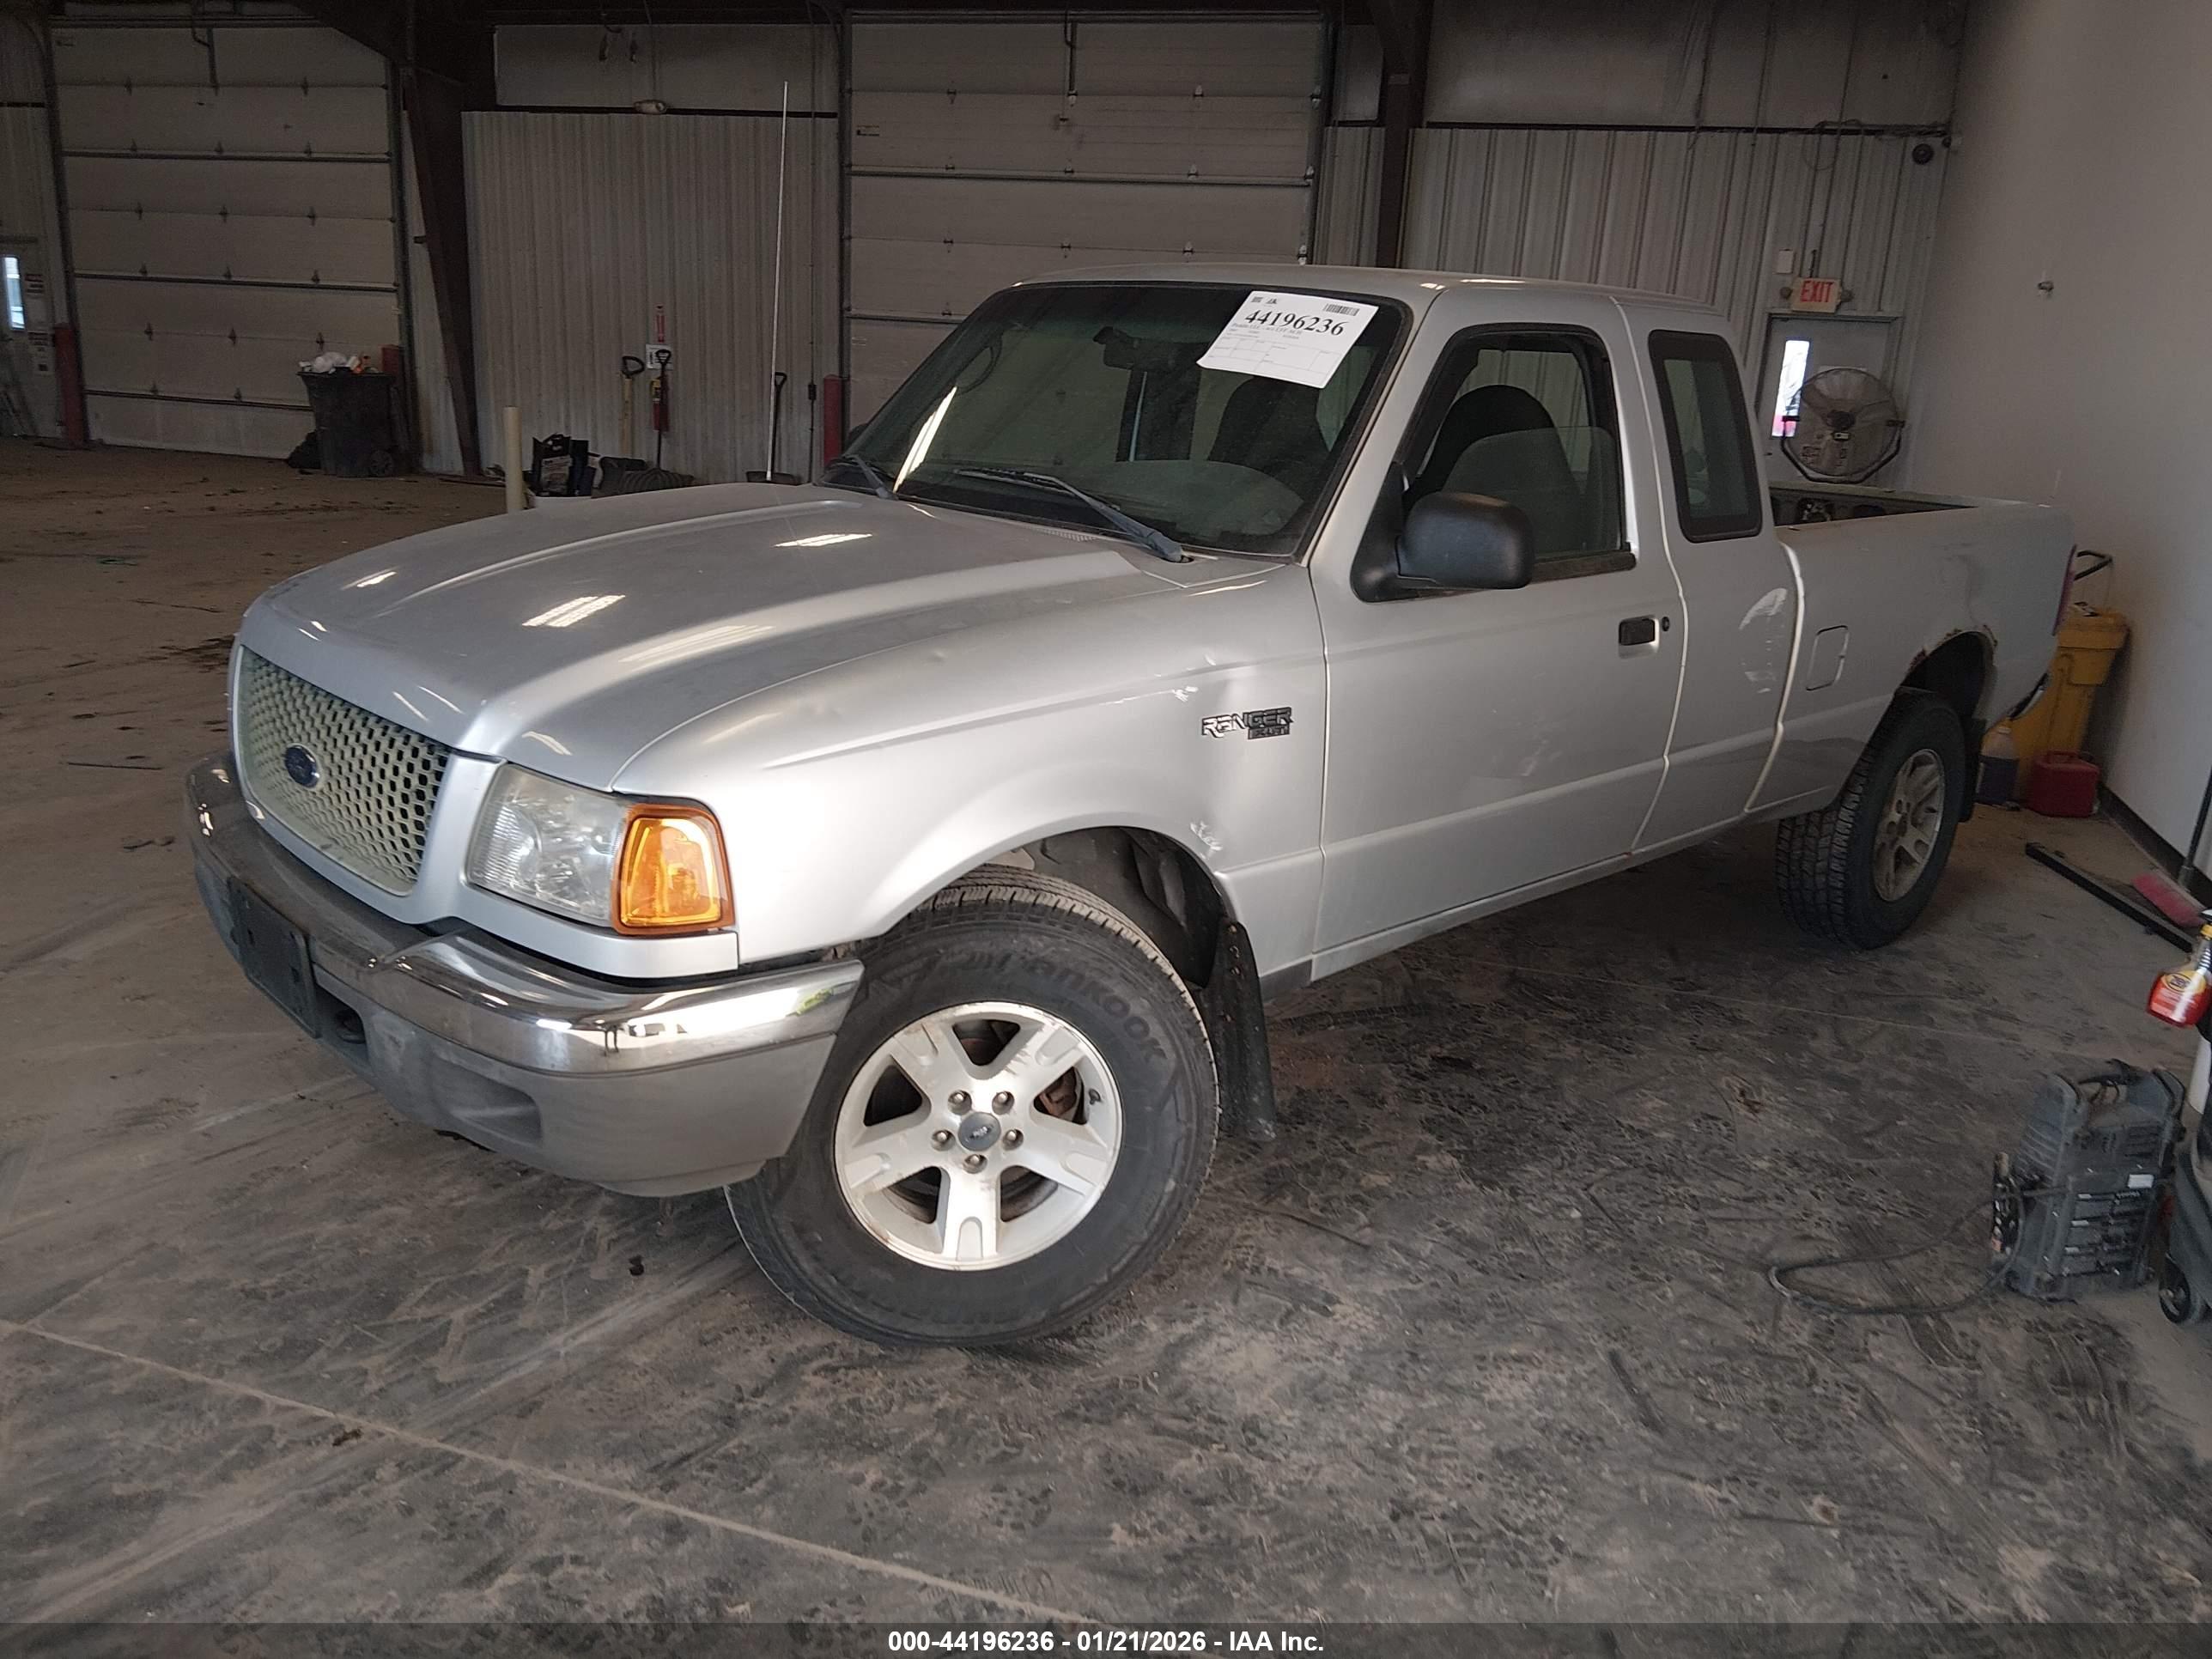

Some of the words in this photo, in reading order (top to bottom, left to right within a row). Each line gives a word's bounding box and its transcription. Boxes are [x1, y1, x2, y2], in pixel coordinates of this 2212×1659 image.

[1800, 280, 1835, 303] EXIT
[1245, 309, 1350, 336] 44196236
[1201, 707, 1294, 738] RANGER
